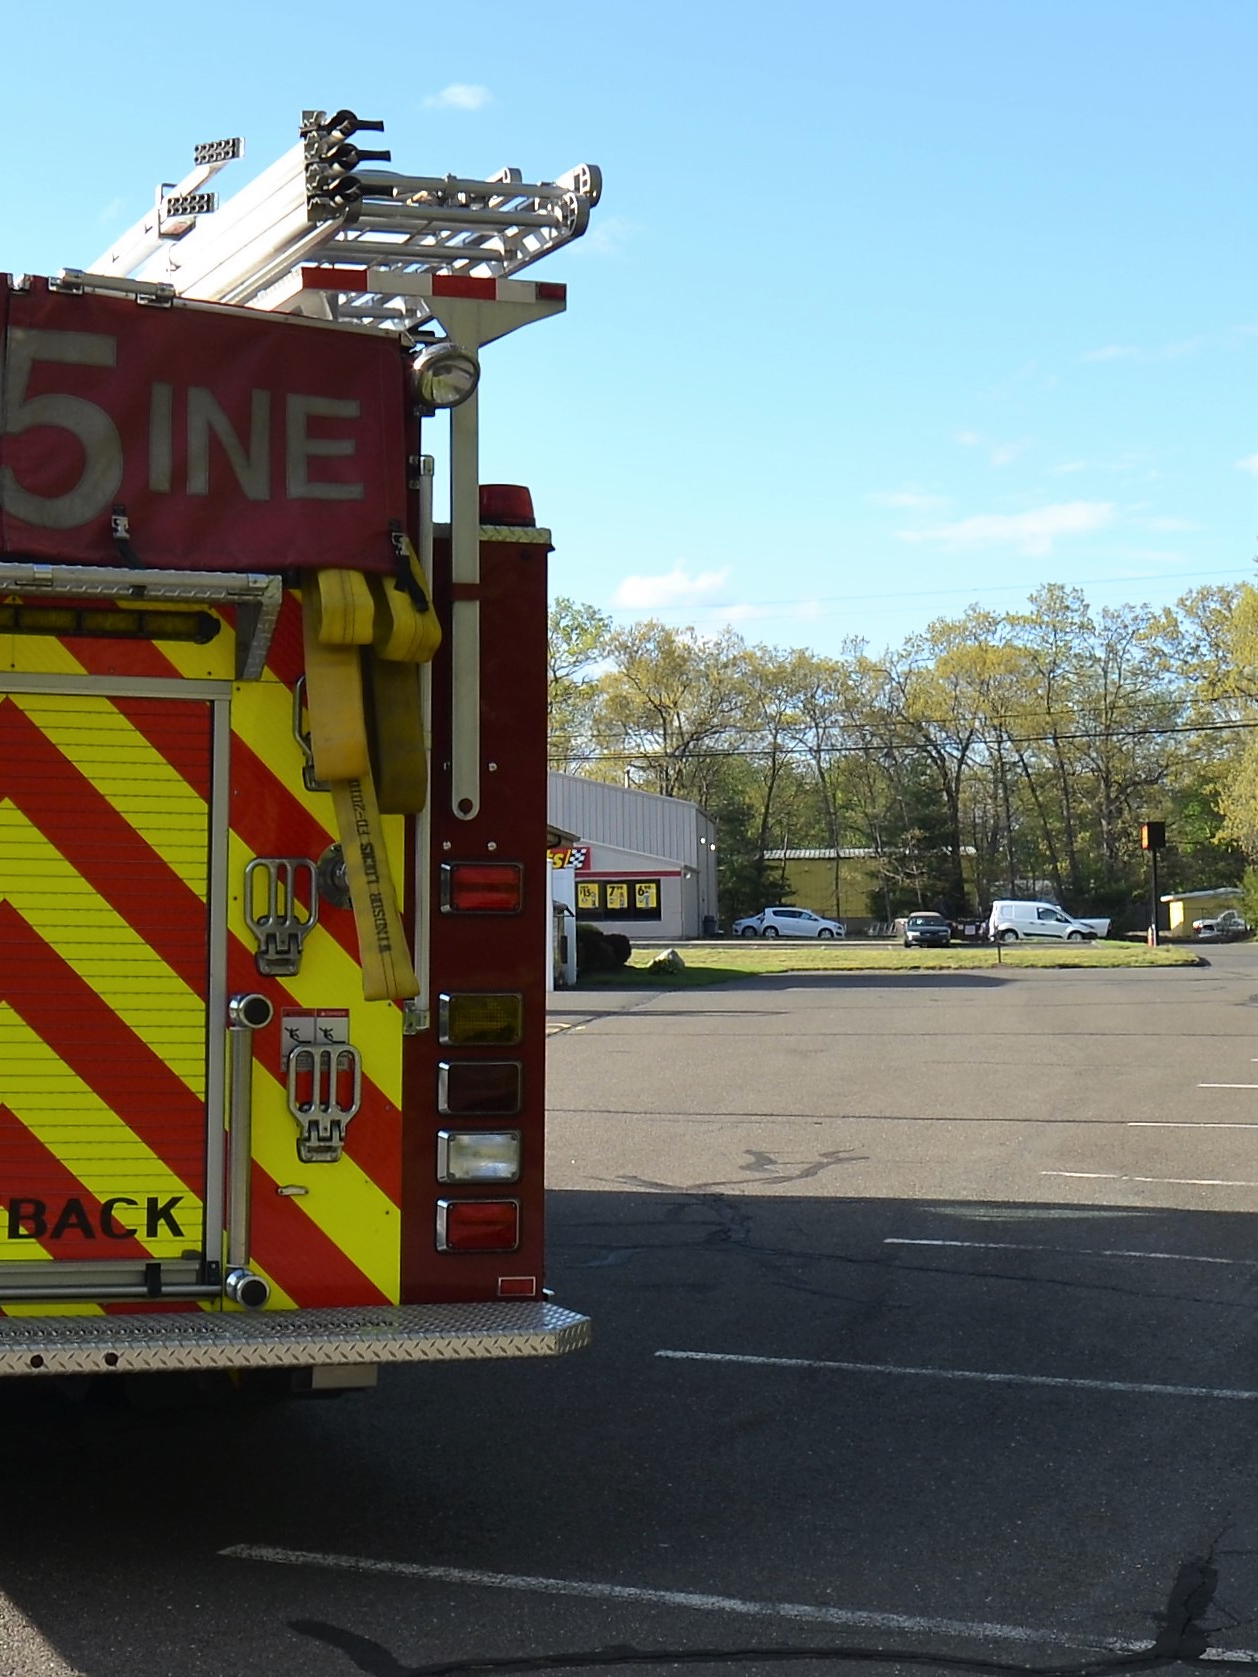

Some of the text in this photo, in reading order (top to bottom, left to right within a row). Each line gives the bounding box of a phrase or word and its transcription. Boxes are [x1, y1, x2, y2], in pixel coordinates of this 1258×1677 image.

[148, 382, 365, 502] INE
[360, 842, 379, 884] LOCKS
[369, 892, 391, 953] WINDSOR
[7, 1196, 185, 1240] BACK
